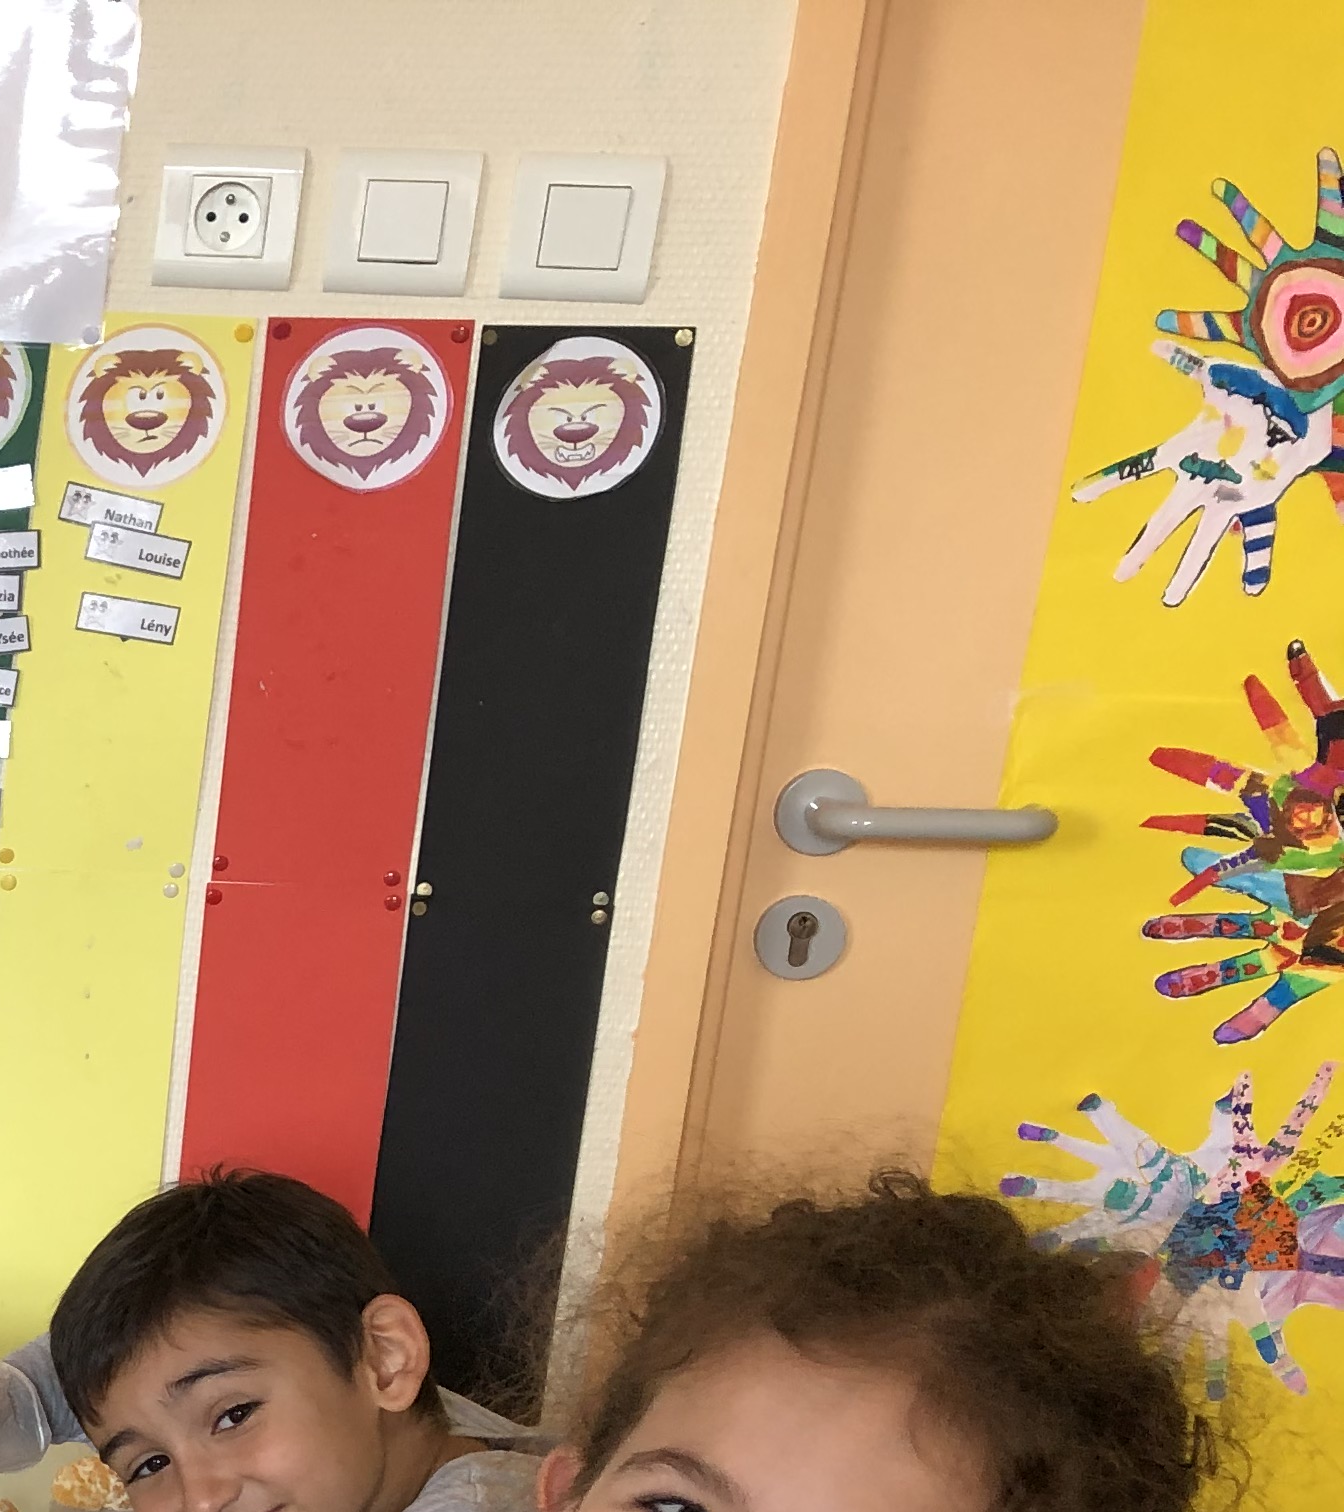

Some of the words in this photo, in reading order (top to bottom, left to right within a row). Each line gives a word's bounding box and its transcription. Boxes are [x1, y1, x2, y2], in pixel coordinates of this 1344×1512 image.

[103, 508, 153, 531] Nathan
[137, 548, 181, 571] Louise
[139, 616, 173, 639] Lény
